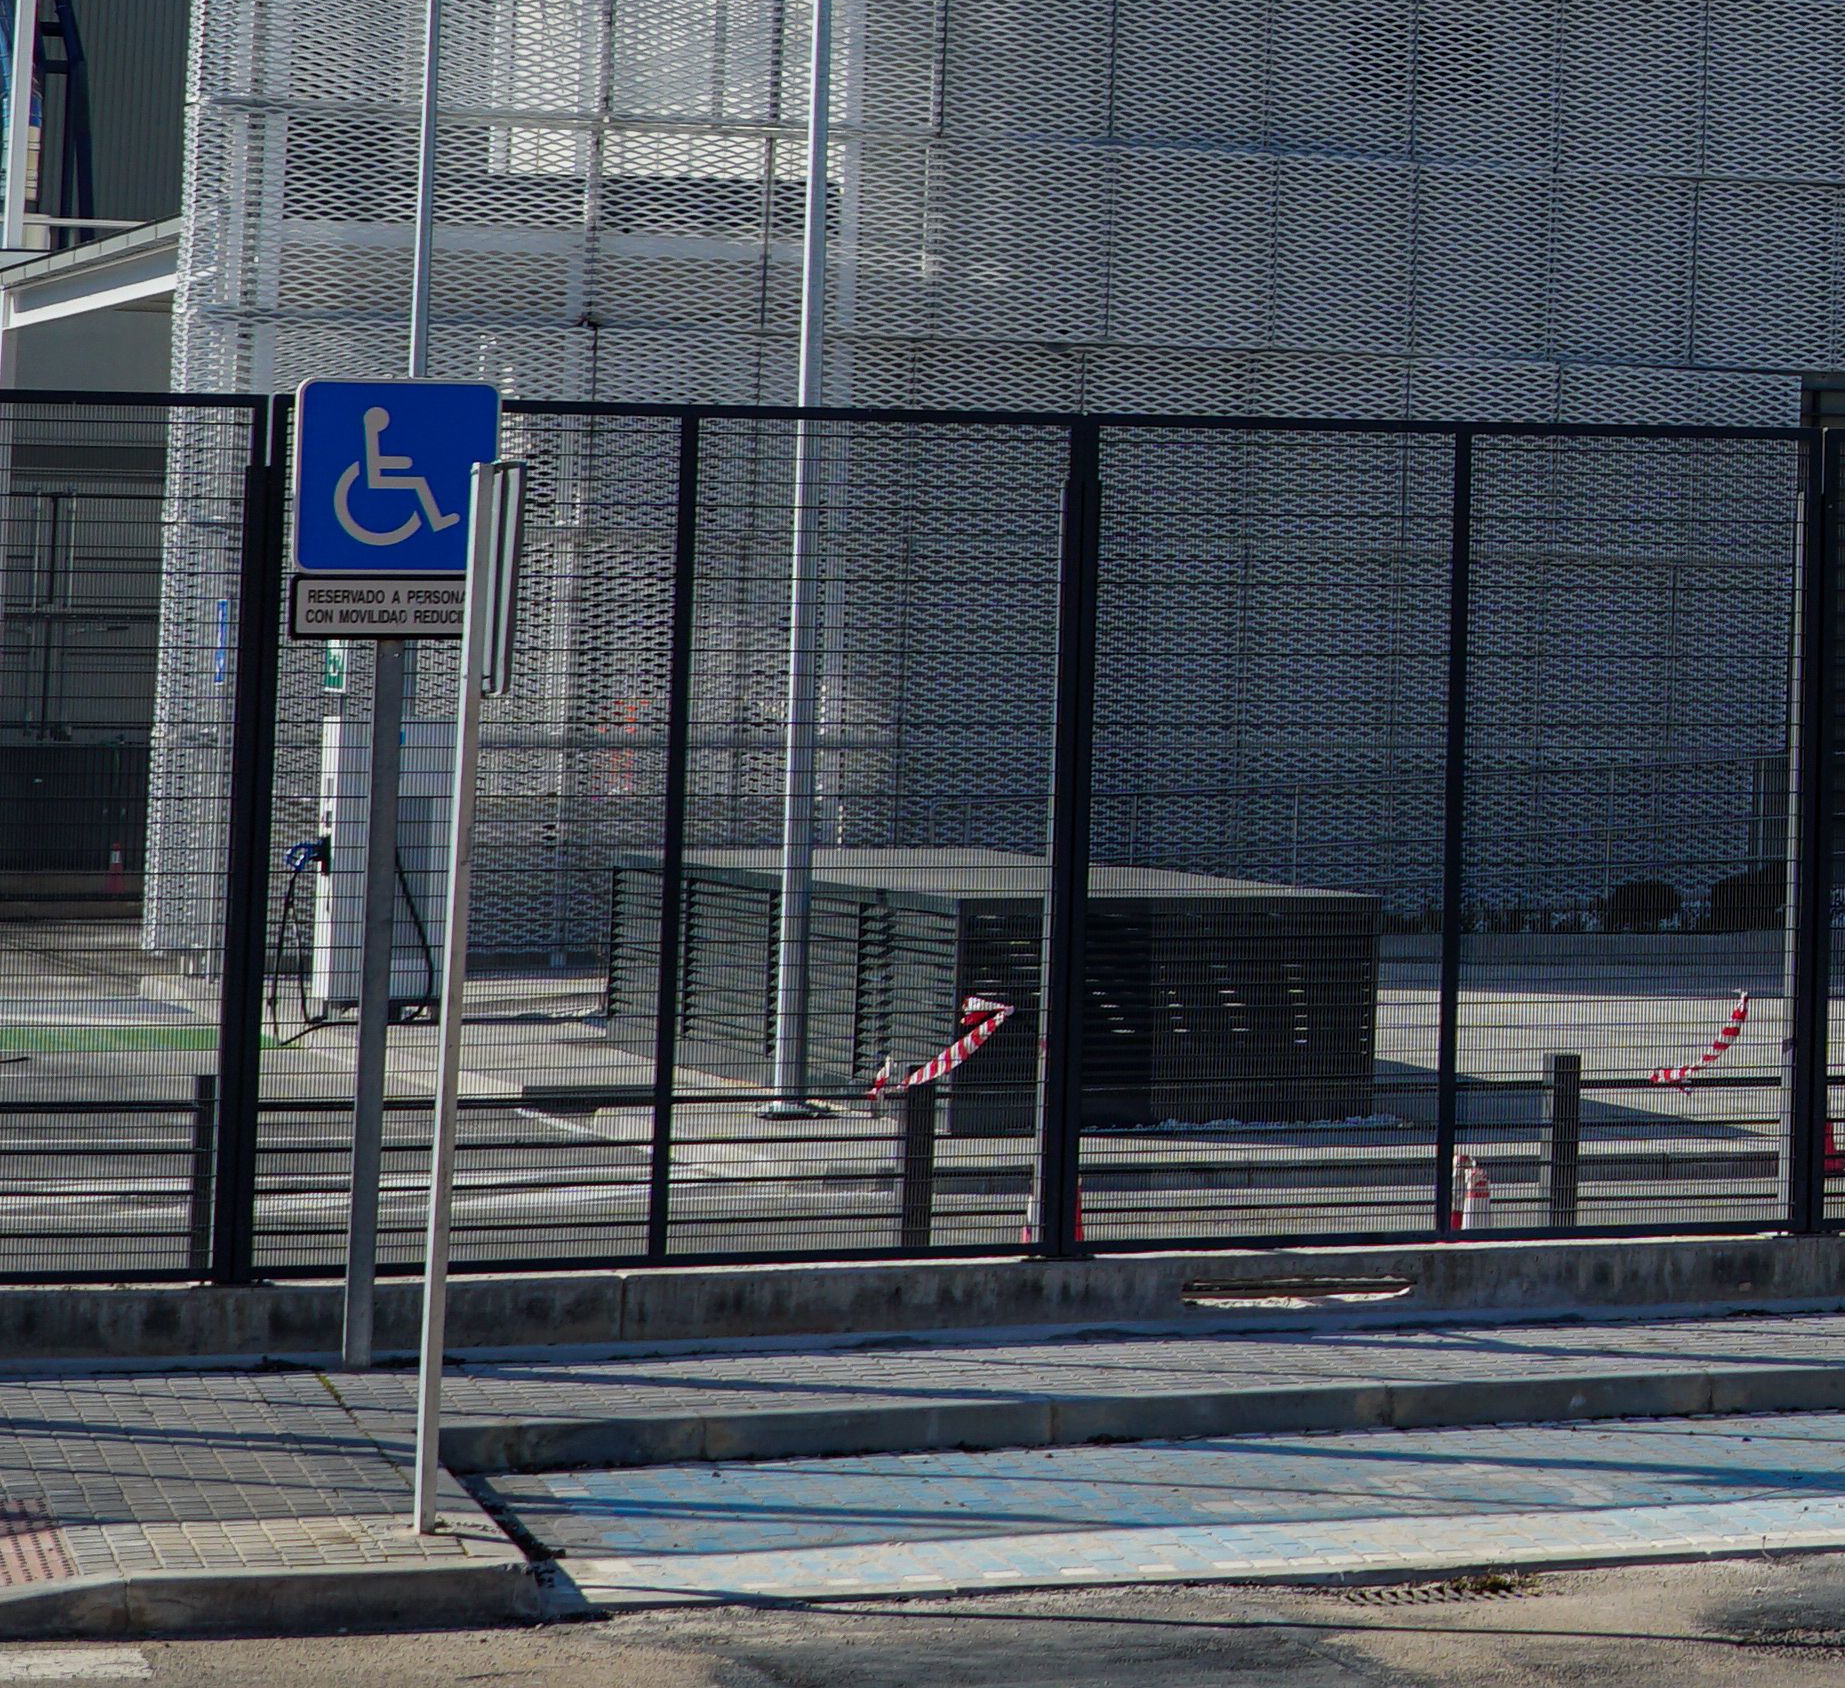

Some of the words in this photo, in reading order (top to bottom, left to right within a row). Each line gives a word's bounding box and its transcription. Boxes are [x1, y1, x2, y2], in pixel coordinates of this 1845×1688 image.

[308, 589, 385, 604] RESERVADO
[392, 590, 401, 604] A
[407, 590, 465, 604] PERSONA
[305, 609, 333, 623] CON
[339, 610, 407, 623] MOVILIDAD
[414, 611, 463, 623] REDUCI
